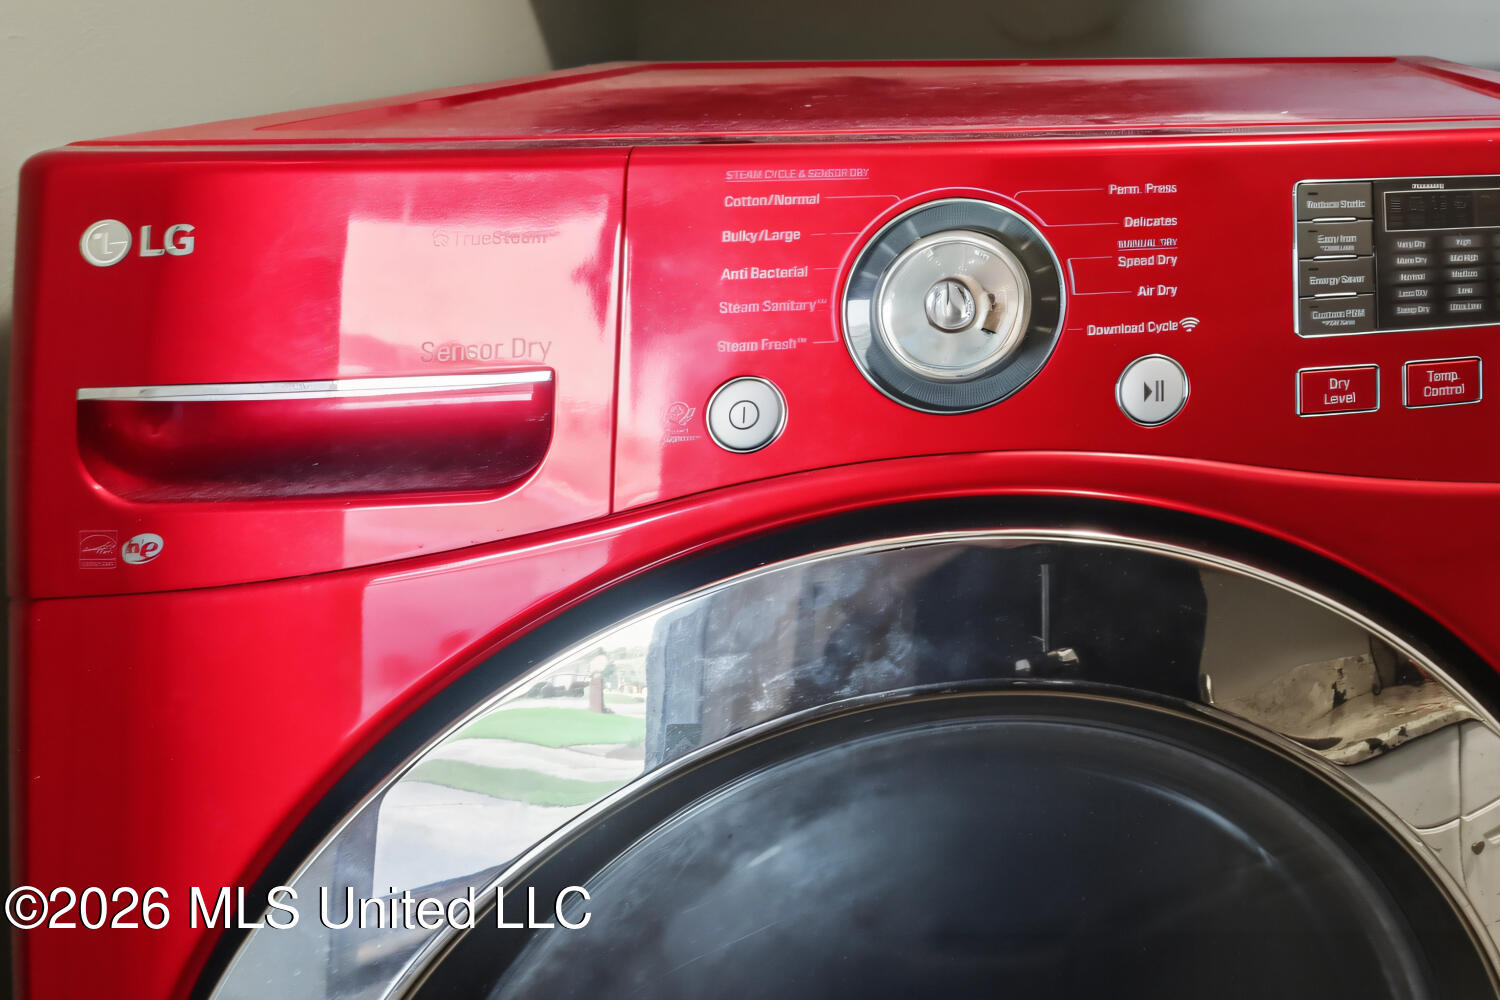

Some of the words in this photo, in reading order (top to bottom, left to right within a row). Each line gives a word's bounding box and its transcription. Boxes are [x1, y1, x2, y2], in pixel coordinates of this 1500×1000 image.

[1109, 184, 1142, 195] Perm.
[1145, 183, 1178, 193] Press
[725, 194, 820, 207] Cotton/Normal
[1124, 216, 1178, 228] Delicates
[140, 223, 195, 257] LG
[722, 230, 801, 243] Bulky/Large
[1118, 256, 1155, 268] Speed
[1157, 255, 1178, 267] Dry
[720, 268, 748, 280] Anti
[750, 266, 808, 279] Bacterial
[1137, 285, 1155, 296] Air
[1157, 284, 1178, 297] Dry
[719, 302, 760, 314] Steam
[1087, 322, 1145, 336] Download
[1147, 320, 1178, 334] Cycle
[421, 341, 504, 363] Sensor
[512, 338, 553, 362] Dry
[717, 340, 759, 353] Steam
[1329, 377, 1351, 391] Dry
[1423, 384, 1465, 398] Control
[1324, 392, 1356, 405] Level
